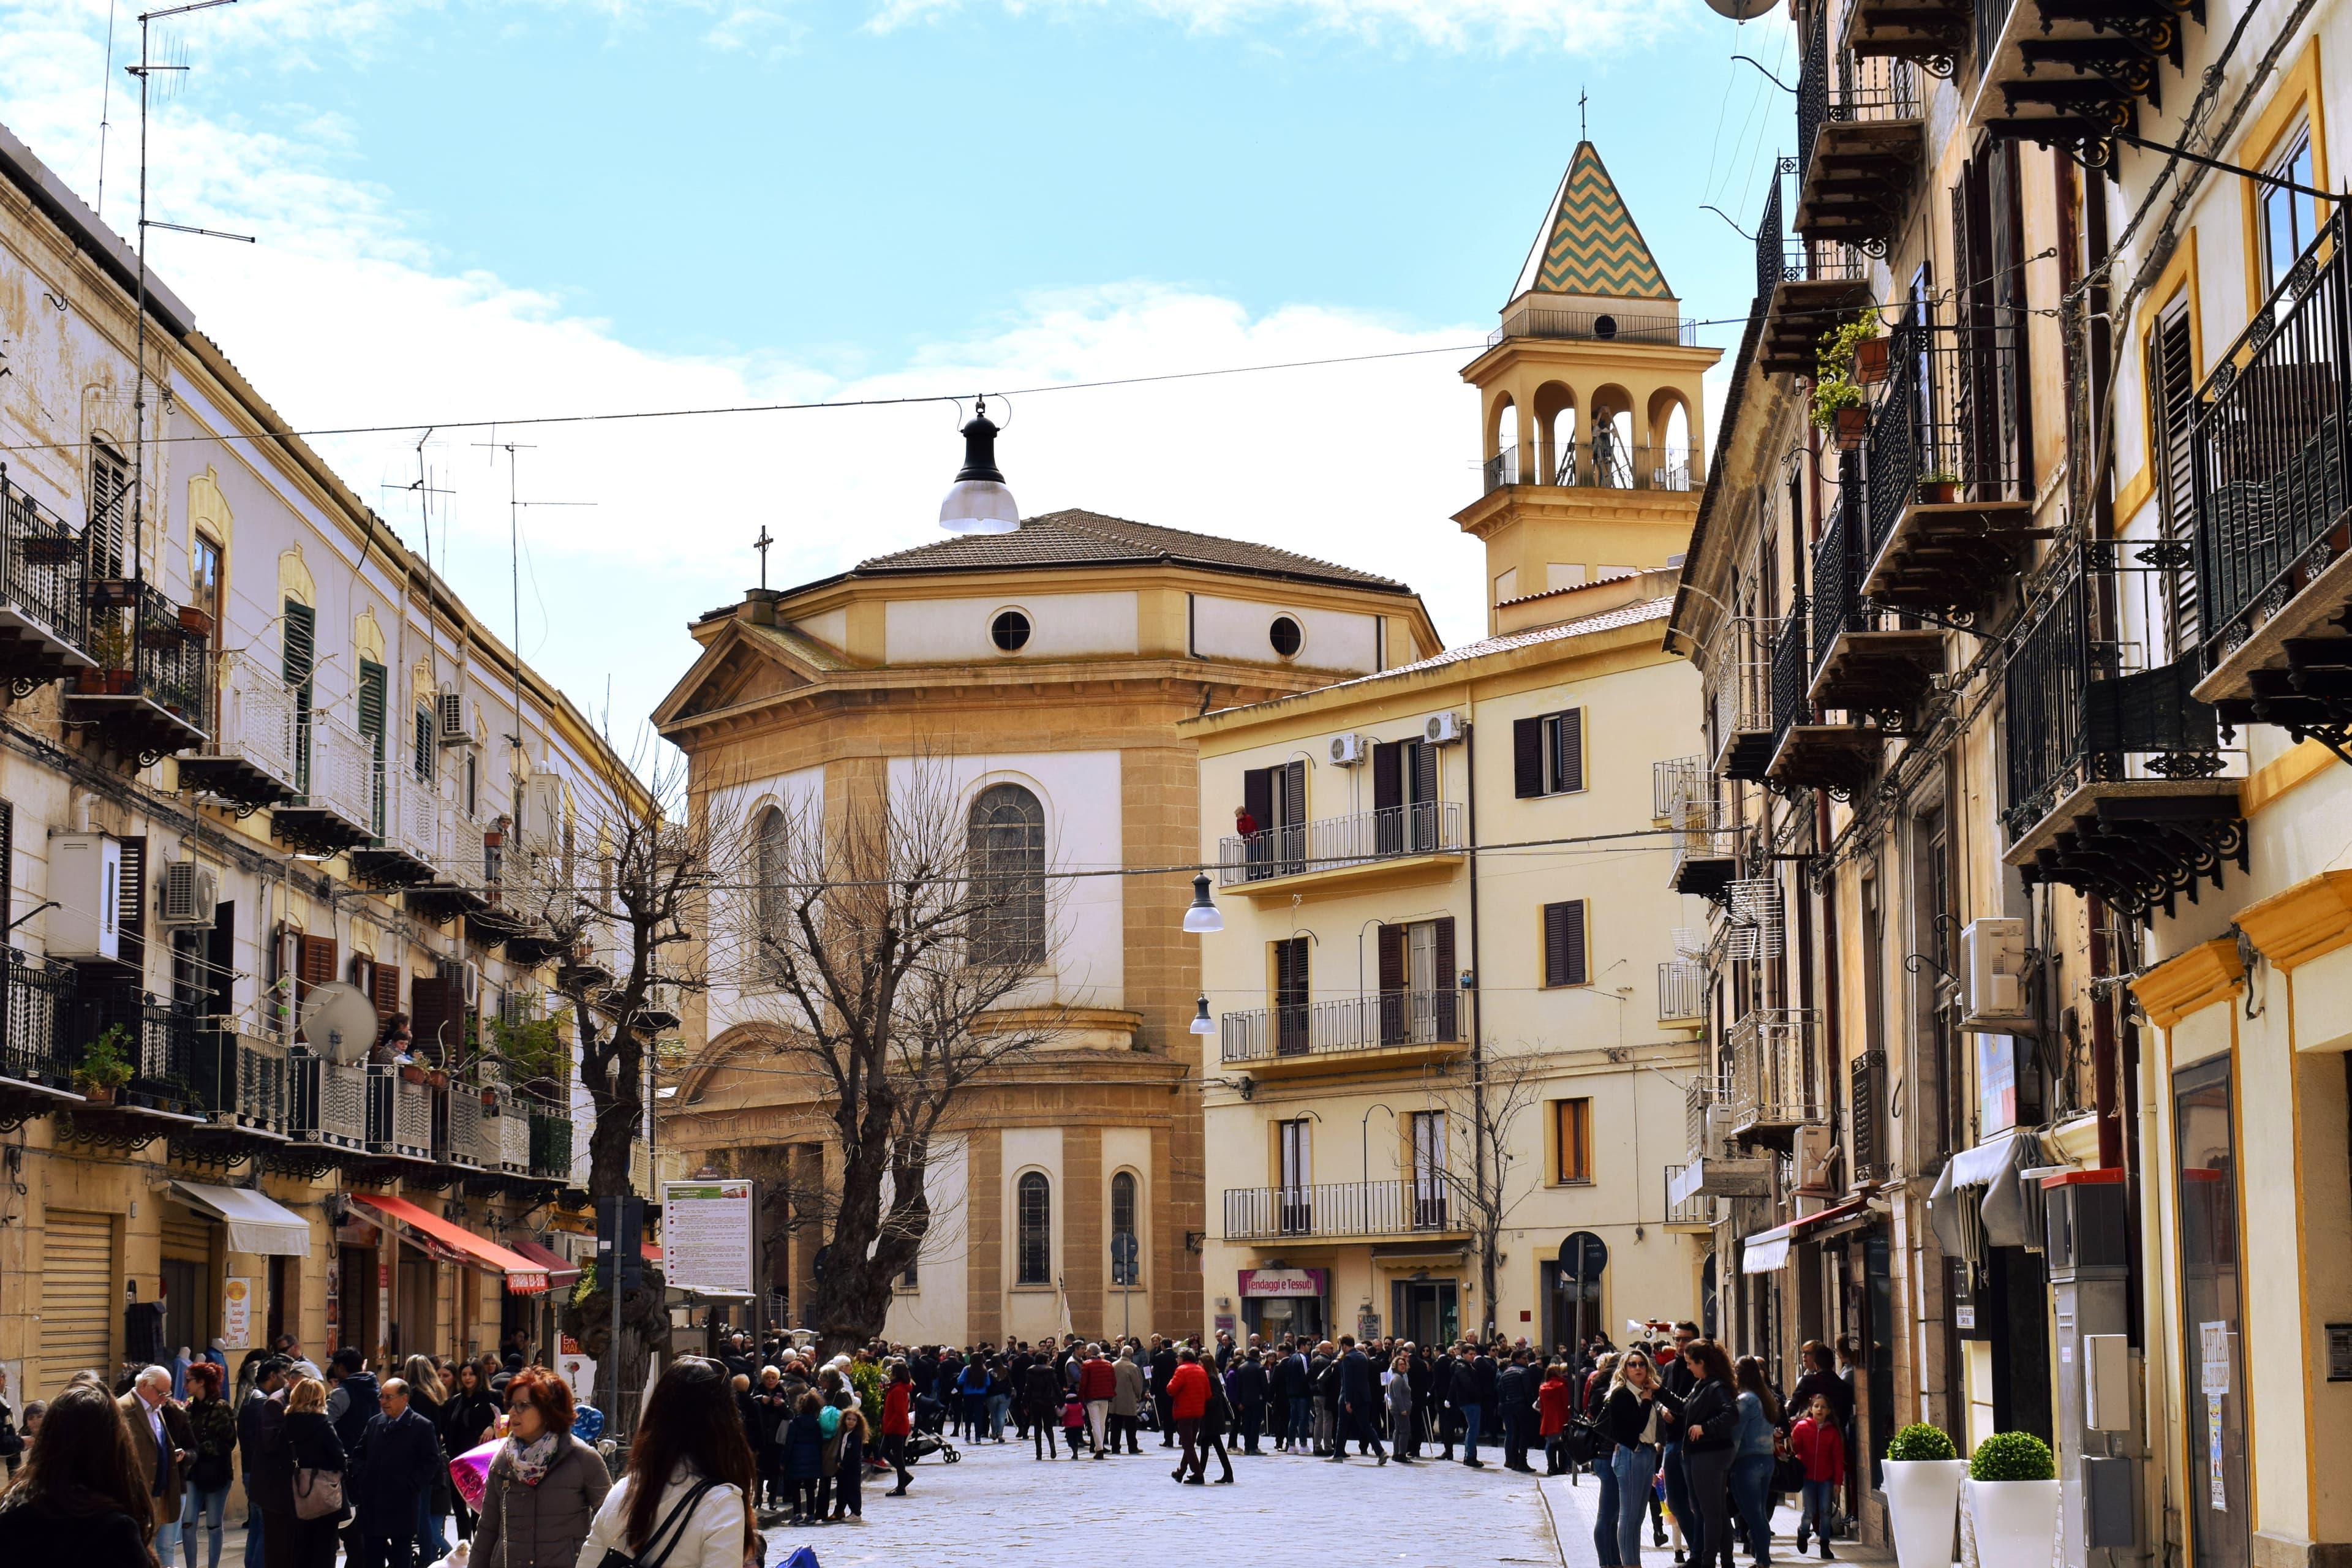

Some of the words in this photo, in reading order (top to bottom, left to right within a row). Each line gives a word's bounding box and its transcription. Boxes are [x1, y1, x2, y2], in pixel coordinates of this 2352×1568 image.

[748, 1114, 784, 1131] LUCIAE
[1247, 1278, 1280, 1291] Tendaggi
[1287, 1278, 1312, 1289] Tessuti
